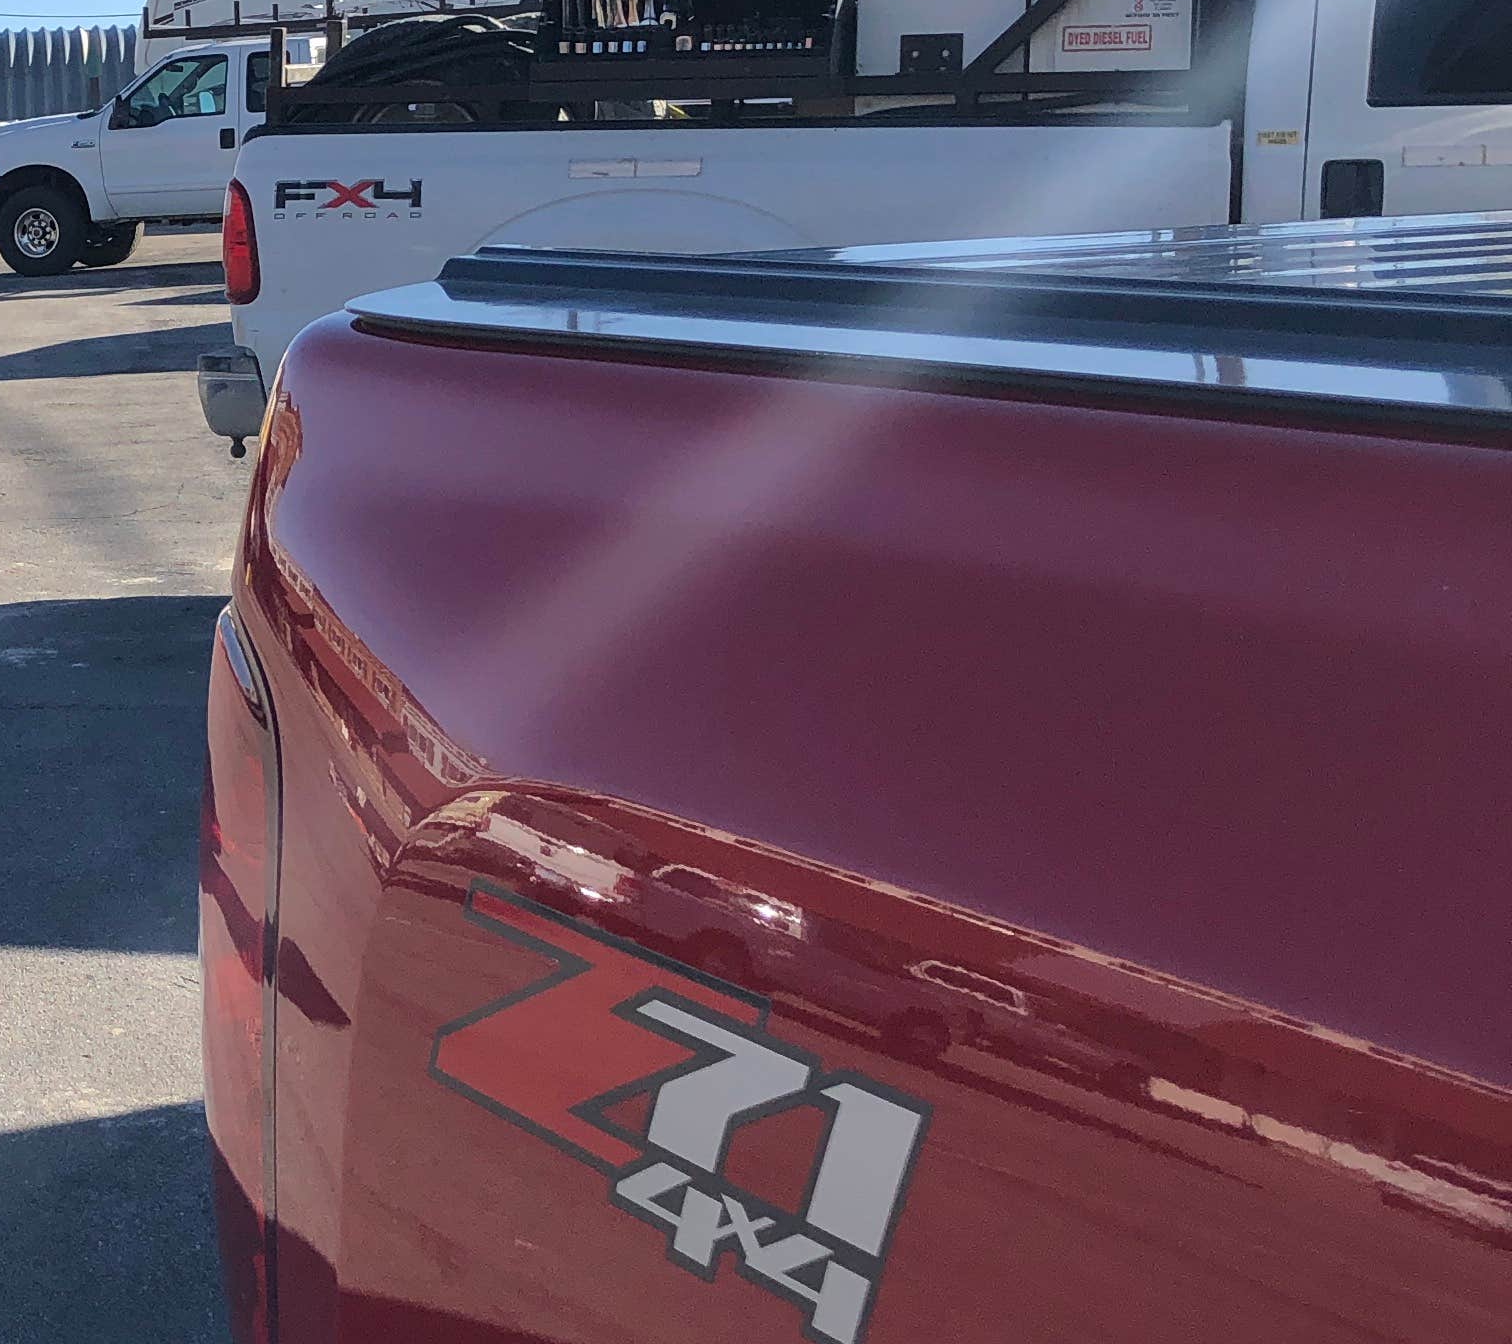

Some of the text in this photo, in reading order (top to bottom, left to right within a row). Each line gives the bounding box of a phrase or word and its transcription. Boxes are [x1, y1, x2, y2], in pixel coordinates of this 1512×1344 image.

[1068, 31, 1148, 45] DYED DIESEL FUEL
[274, 179, 423, 209] FX4
[428, 878, 931, 1258] Z71
